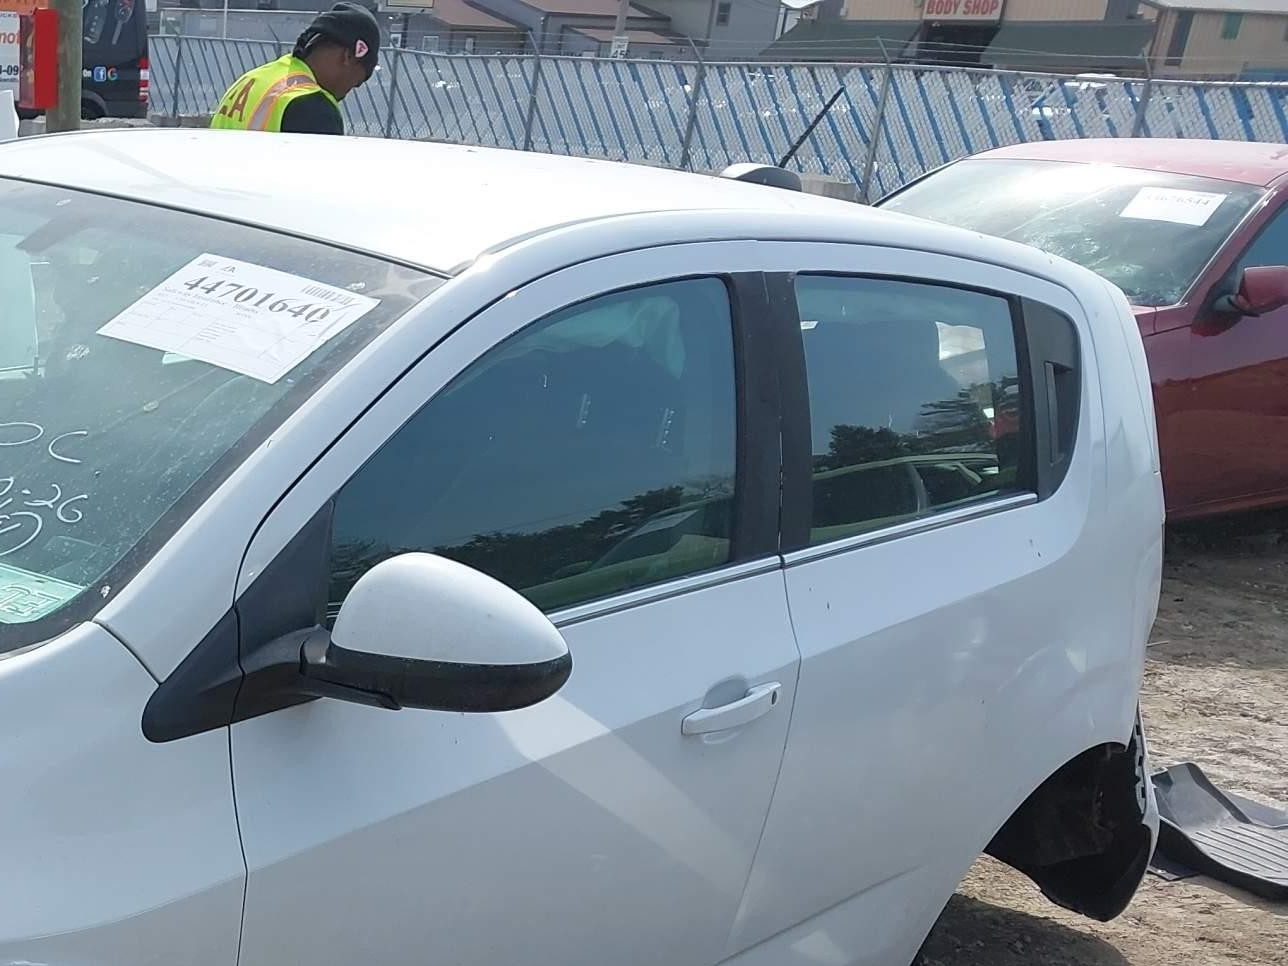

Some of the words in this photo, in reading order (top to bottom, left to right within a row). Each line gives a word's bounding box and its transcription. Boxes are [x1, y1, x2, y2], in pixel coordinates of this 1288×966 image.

[926, 0, 959, 14] BODY
[963, 0, 999, 15] SHOP
[184, 275, 331, 323] 44701640
